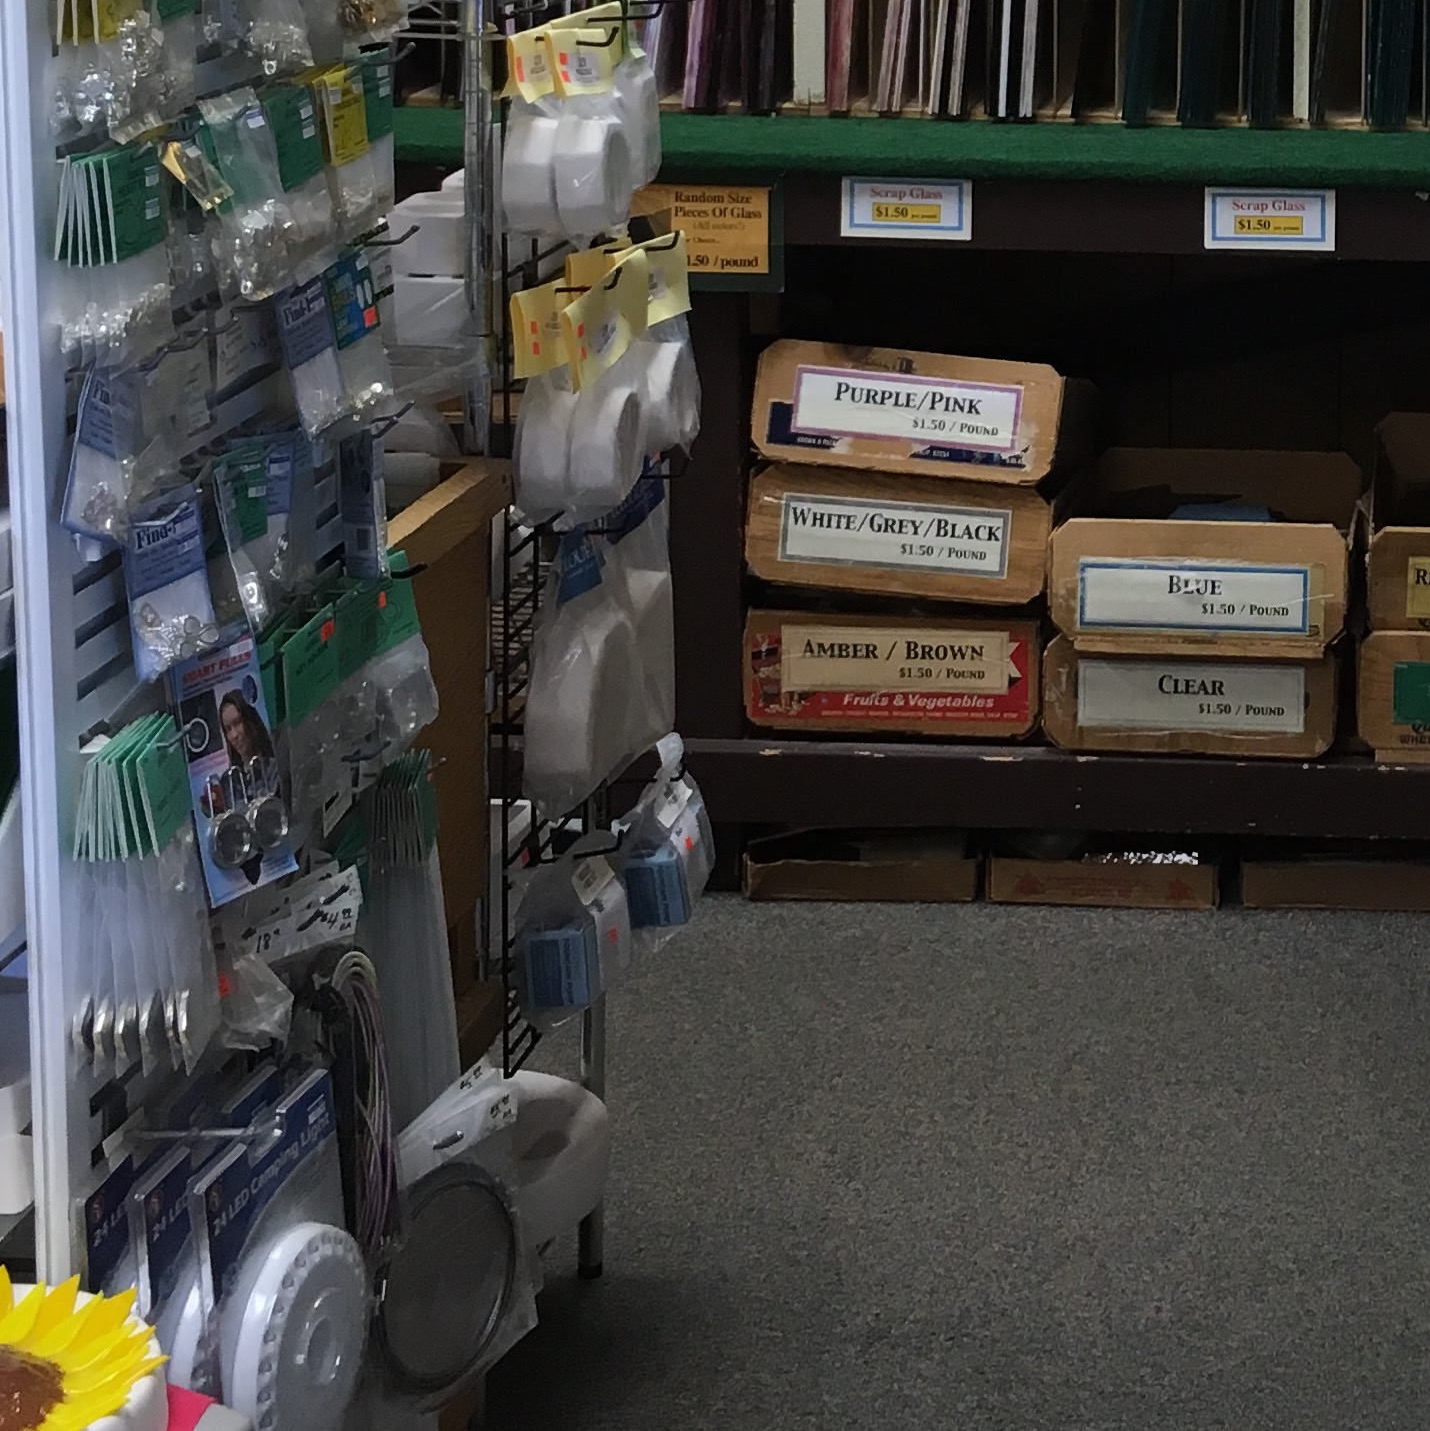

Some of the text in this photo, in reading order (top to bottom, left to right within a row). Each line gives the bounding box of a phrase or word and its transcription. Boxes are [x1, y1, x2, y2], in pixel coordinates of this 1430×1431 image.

[675, 191, 752, 204] Random Size
[870, 187, 943, 201] Scrap Glass
[674, 206, 763, 219] Pieces Of Glass
[875, 206, 909, 219] $1.50
[1231, 198, 1306, 213] Scrap Glass
[1237, 218, 1271, 231] $1.50
[686, 254, 709, 267] 1.50
[720, 256, 759, 269] pound
[911, 416, 946, 432] $1.50
[899, 542, 934, 557] $1.50
[1201, 602, 1236, 616] $1.50
[898, 667, 933, 679] $1.50
[843, 692, 995, 710] Fruits & Vegetables
[1198, 702, 1232, 716] $1.50
[213, 1112, 331, 1237] 24 LED Camping Light
[151, 1217, 167, 1242] 24
